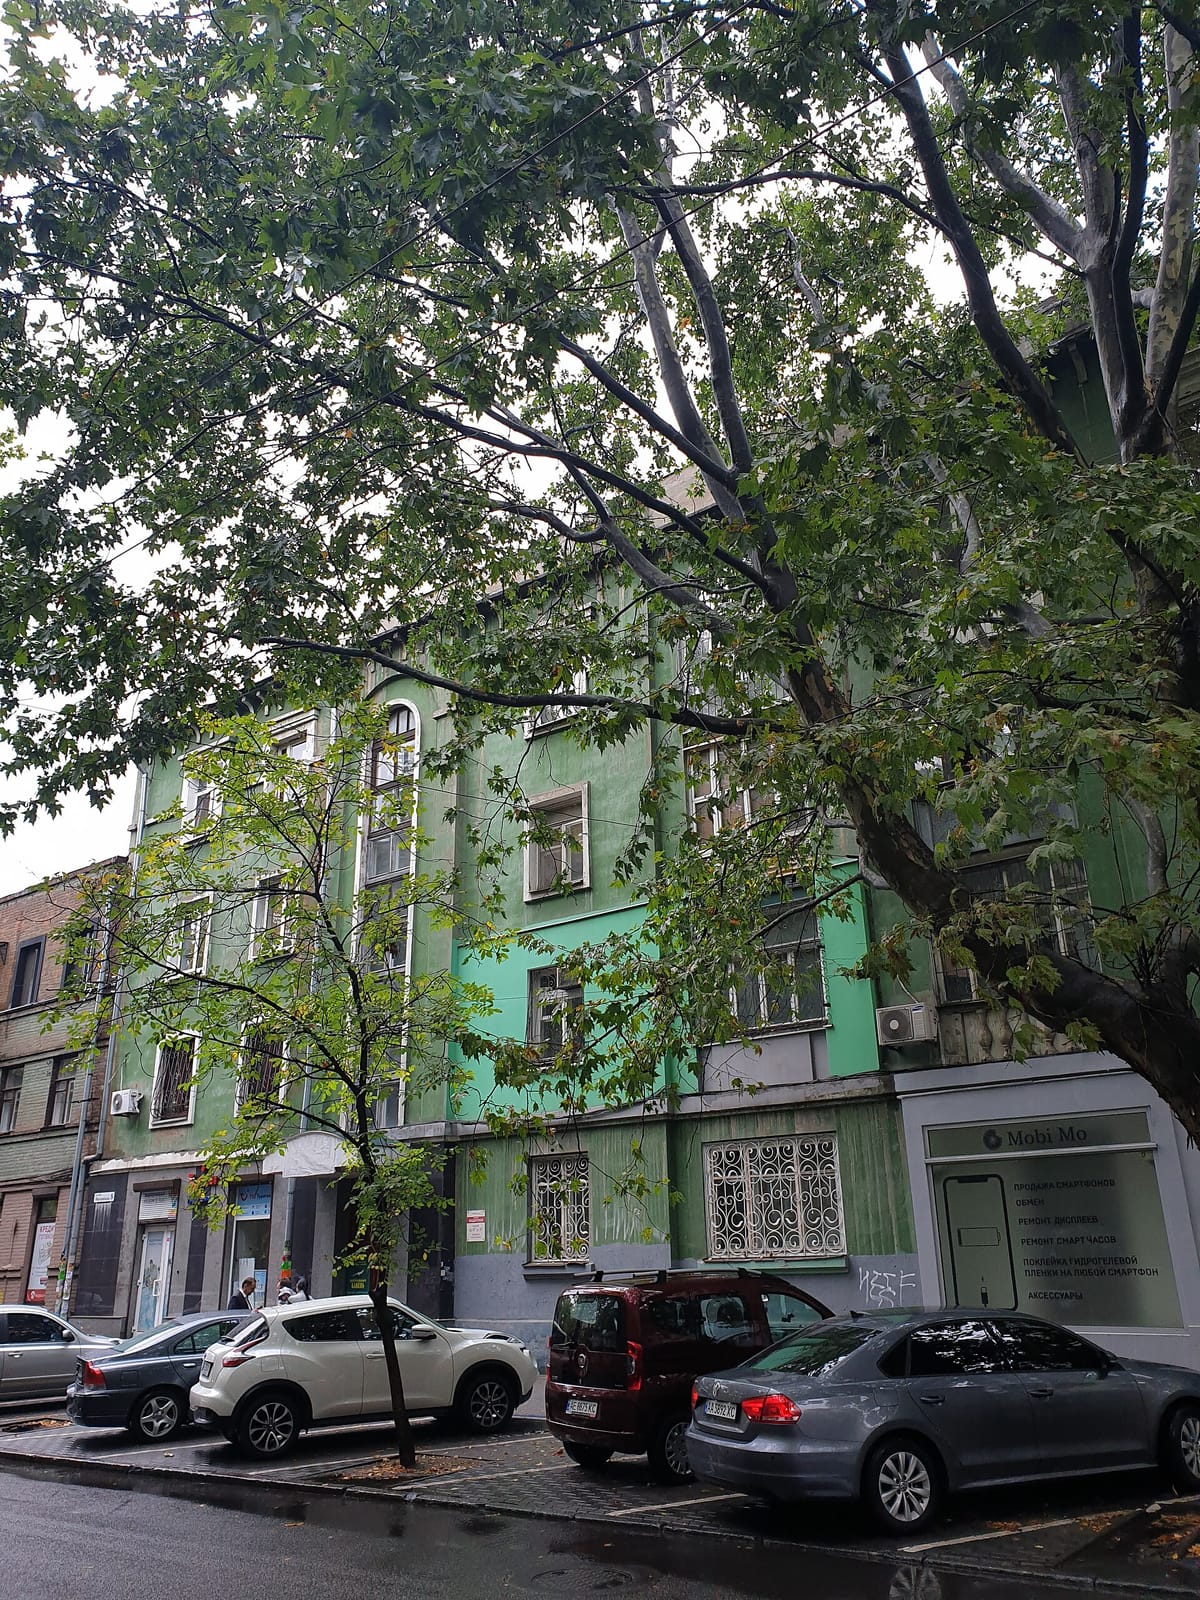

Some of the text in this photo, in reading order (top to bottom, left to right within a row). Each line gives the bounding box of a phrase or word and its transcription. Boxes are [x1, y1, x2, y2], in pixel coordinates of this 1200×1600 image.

[1007, 1125, 1088, 1147] Mobi Mo
[1014, 1178, 1116, 1193] ПРОДАЖА СМАРТФОНОВ
[1015, 1198, 1045, 1207] ОБМЕН
[1018, 1215, 1099, 1226] РЕМОНТ ДИСПЛЕЕВ
[1021, 1235, 1117, 1247] РЕМОНТ СМАРТ ЧАСОВ
[1023, 1254, 1138, 1267] ПОКЛЕЙКА ГИДРОГЕЛЕВОЙ
[1024, 1266, 1159, 1278] ПЛЕНКИ НА ЛЮБОЙ СМАРТФОН
[1028, 1290, 1084, 1301] АКСЕССУАРЫ
